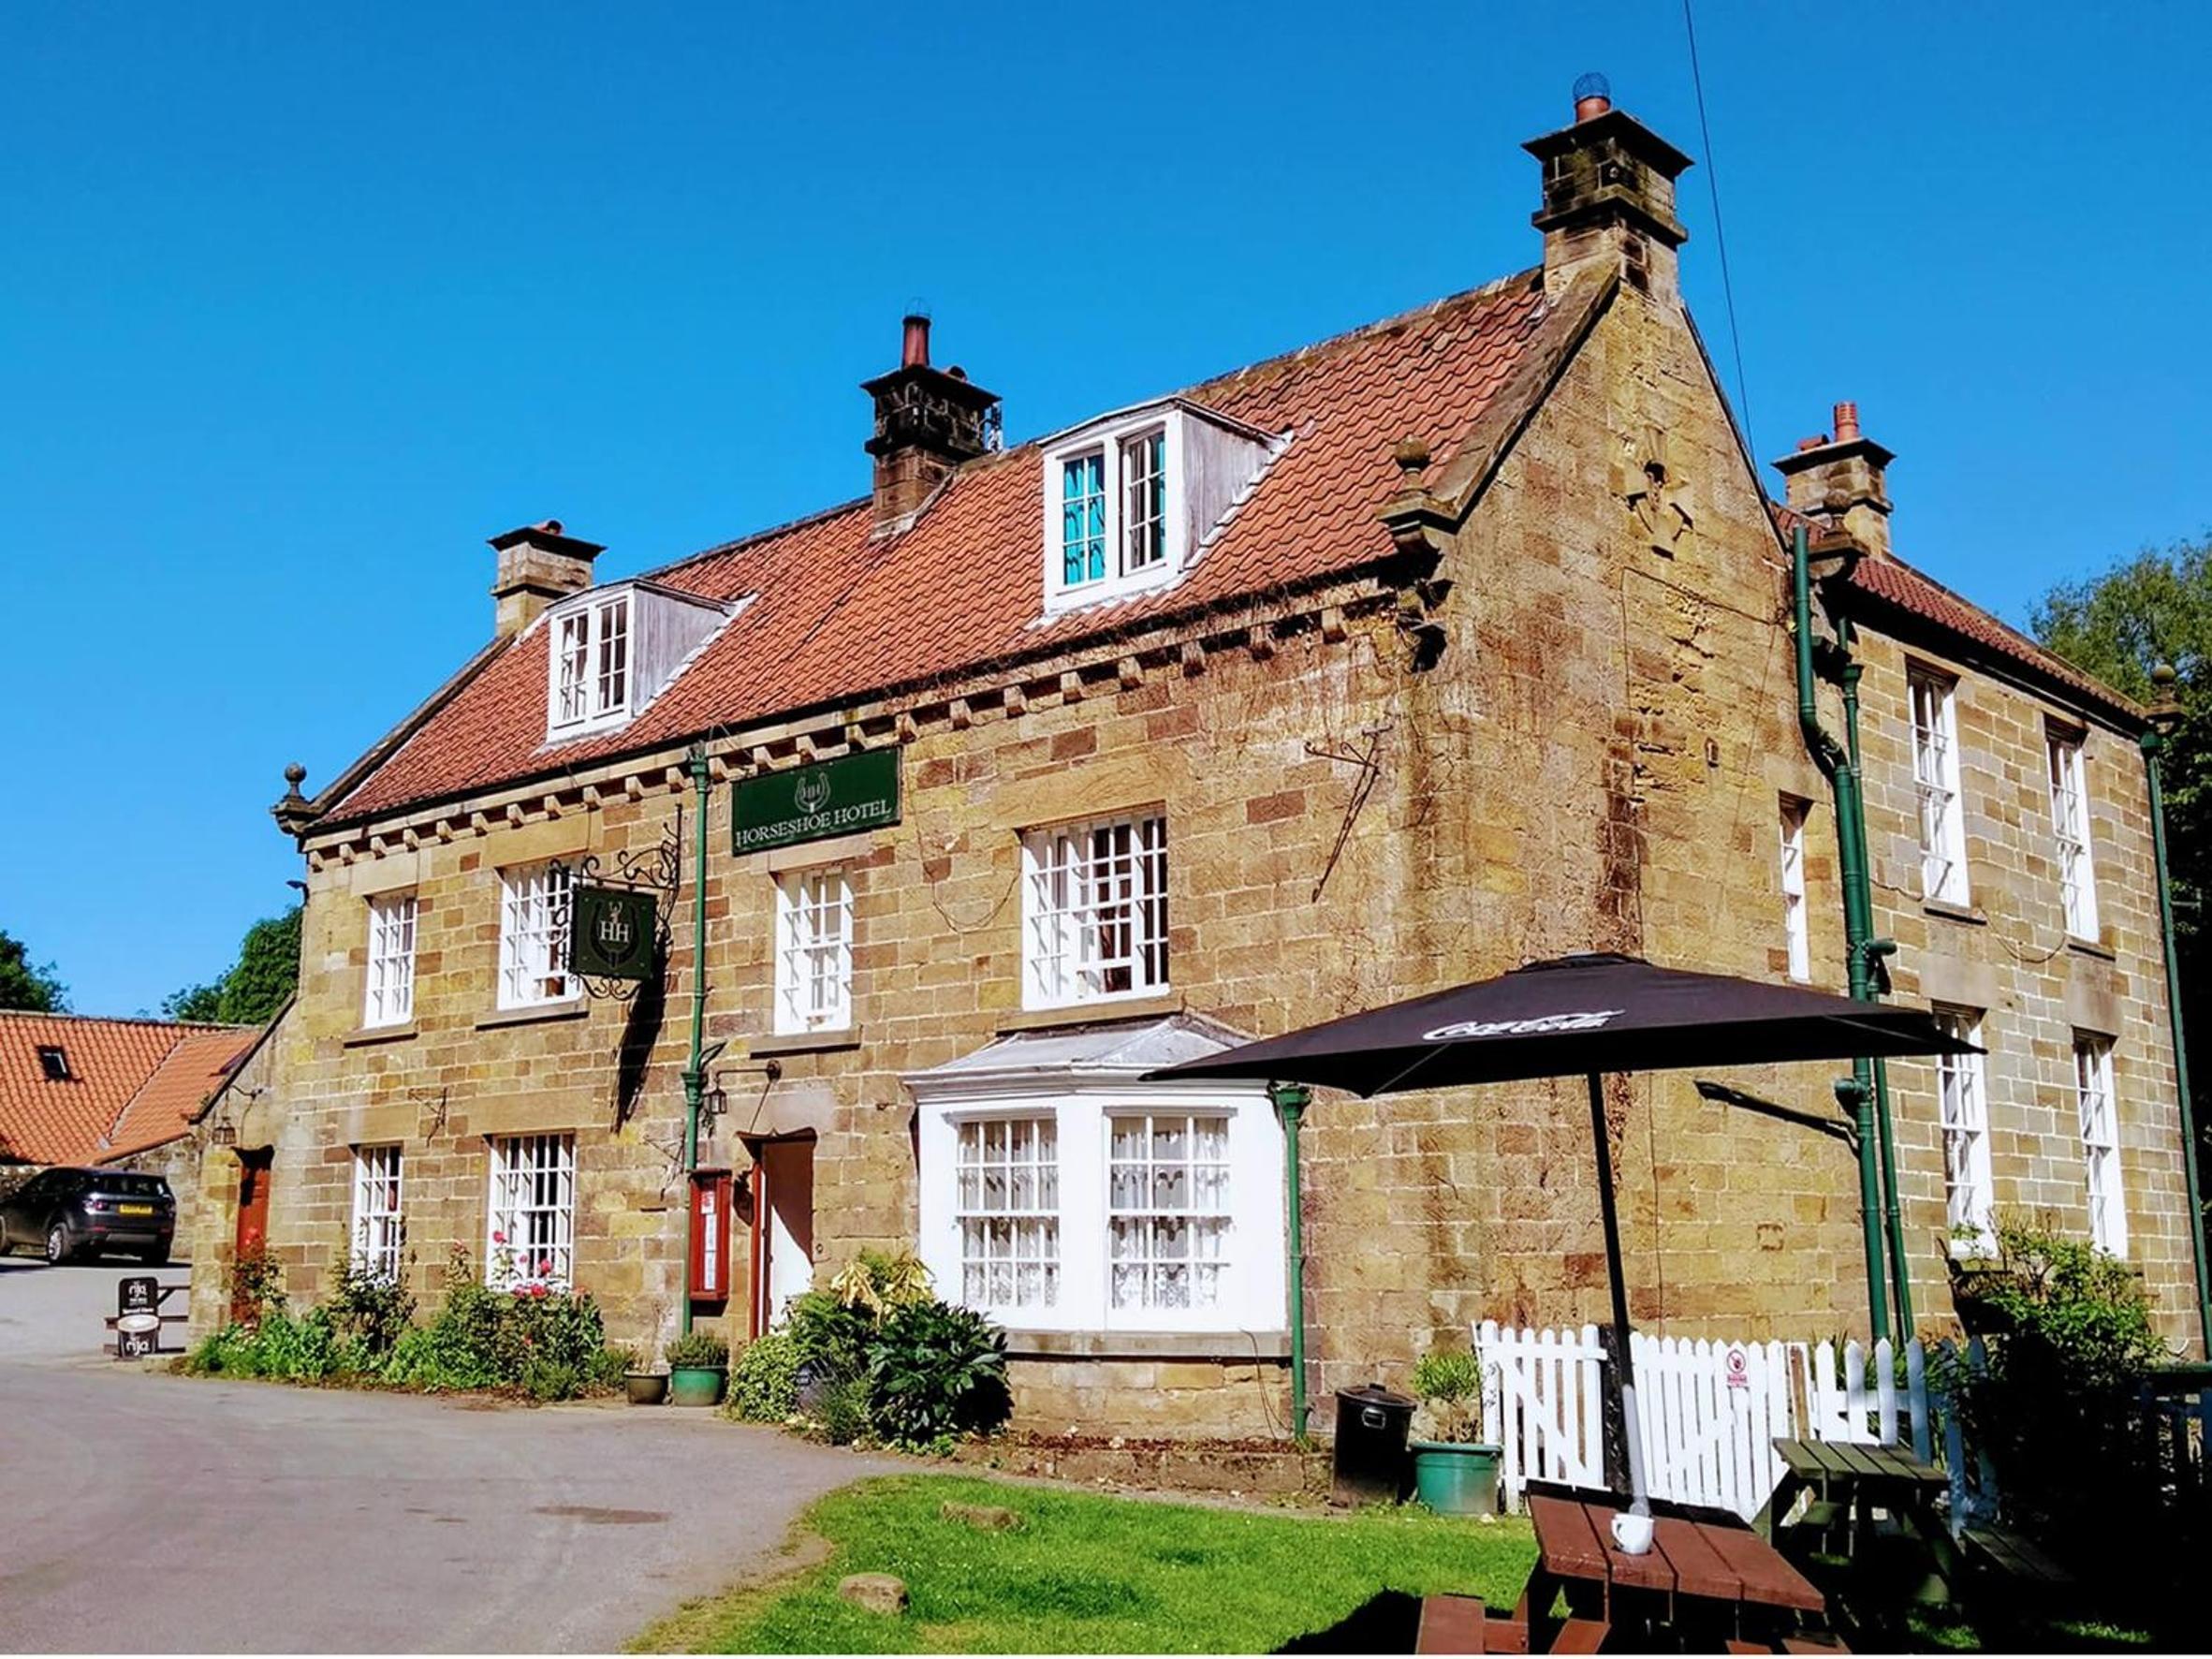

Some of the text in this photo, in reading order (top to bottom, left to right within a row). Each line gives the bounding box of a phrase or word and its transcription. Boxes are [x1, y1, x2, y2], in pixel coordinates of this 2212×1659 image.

[736, 800, 892, 847] HORSESHOE HOTEL
[599, 920, 629, 943] HH
